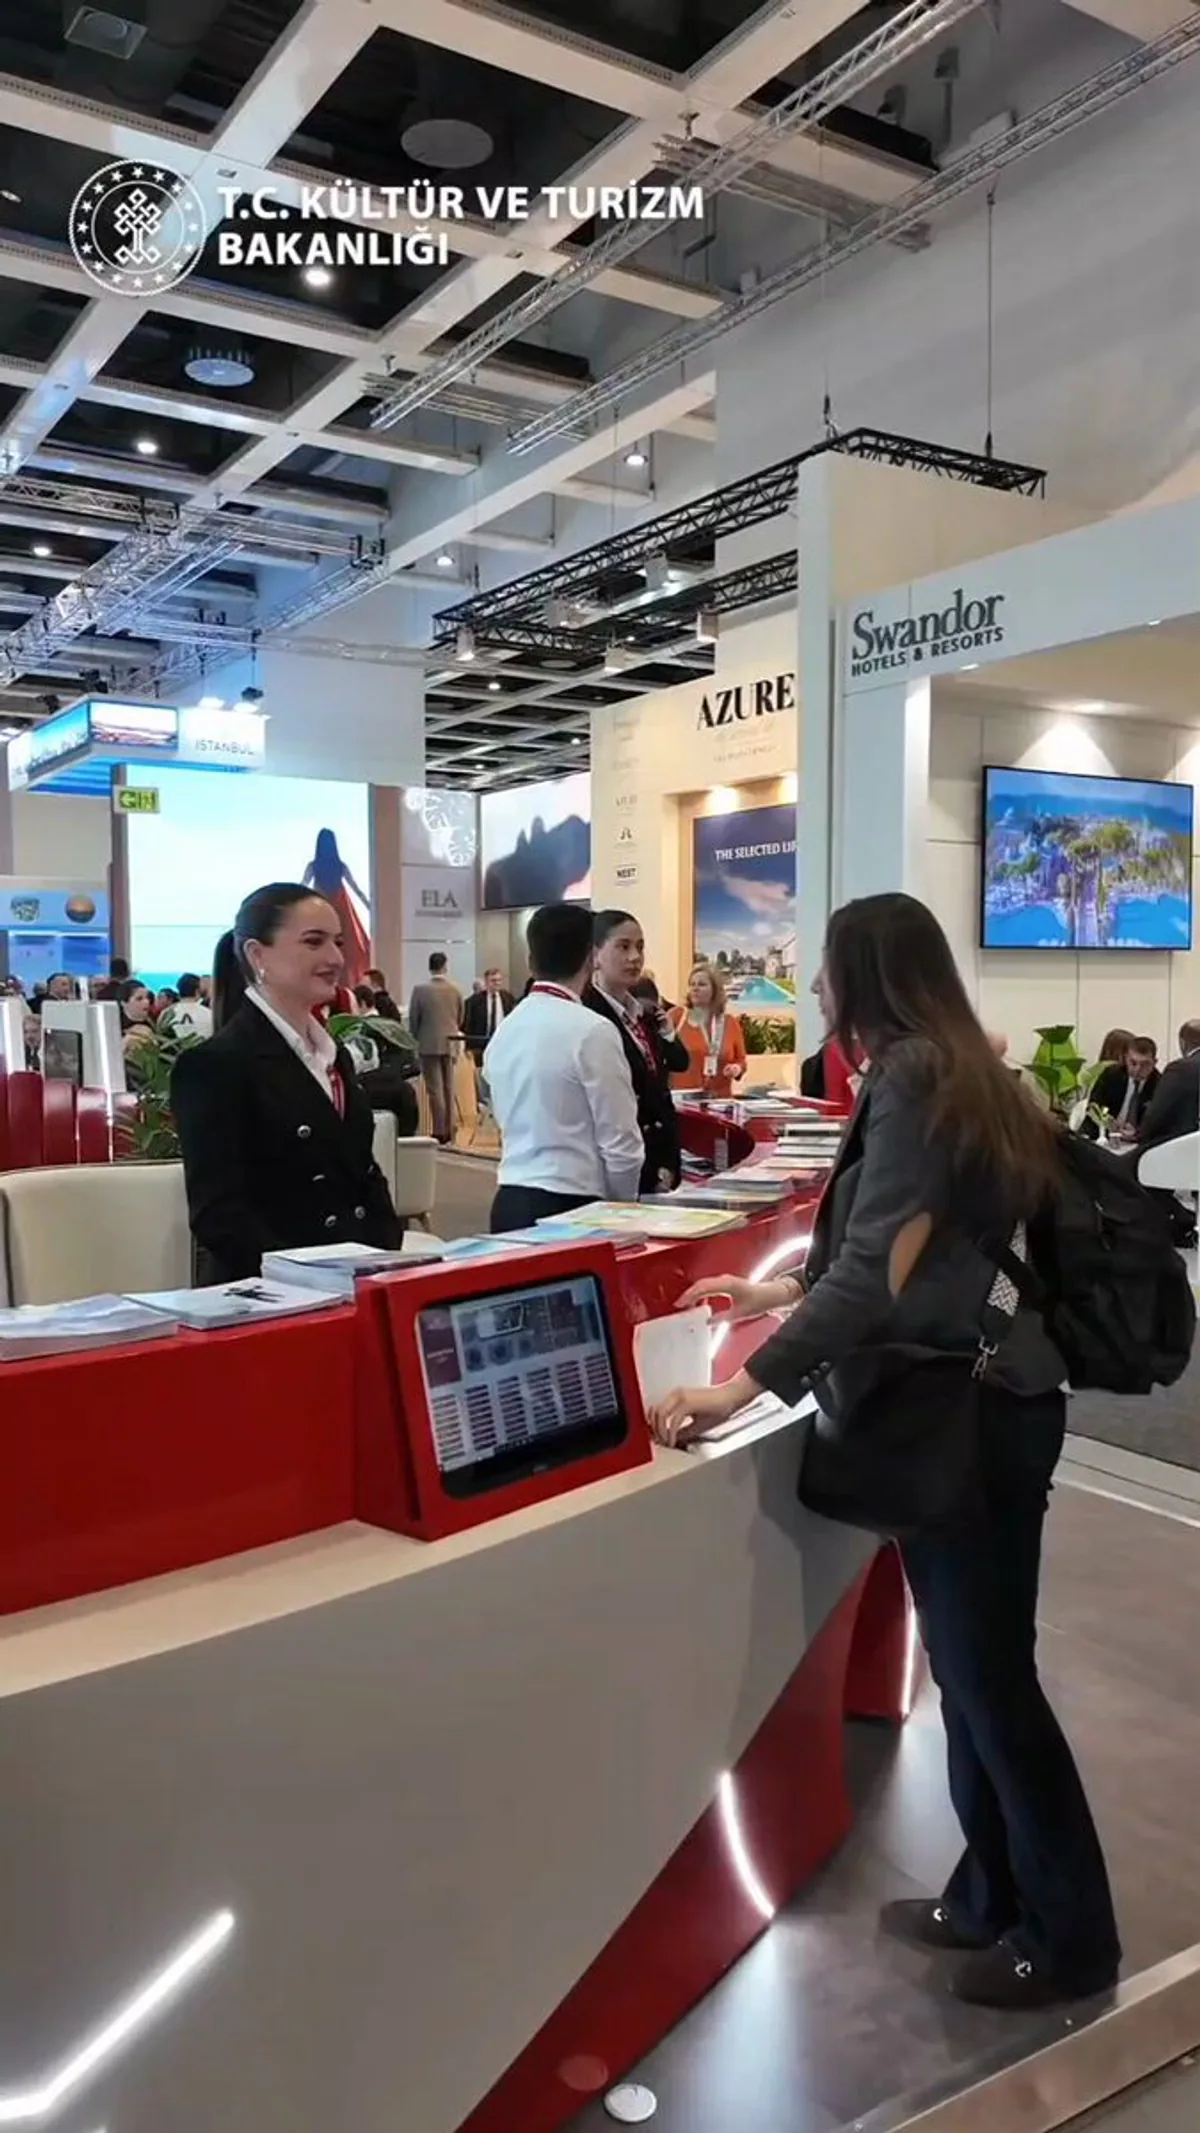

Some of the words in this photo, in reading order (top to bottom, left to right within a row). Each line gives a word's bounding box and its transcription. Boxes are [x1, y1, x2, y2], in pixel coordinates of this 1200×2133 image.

[852, 588, 1005, 660] Swandor
[851, 652, 906, 677] HOTELS
[931, 627, 1004, 657] RESORTS
[697, 673, 795, 731] AZURE
[715, 848, 733, 862] THE
[735, 842, 780, 859] SELECTED
[421, 889, 458, 908] ELA
